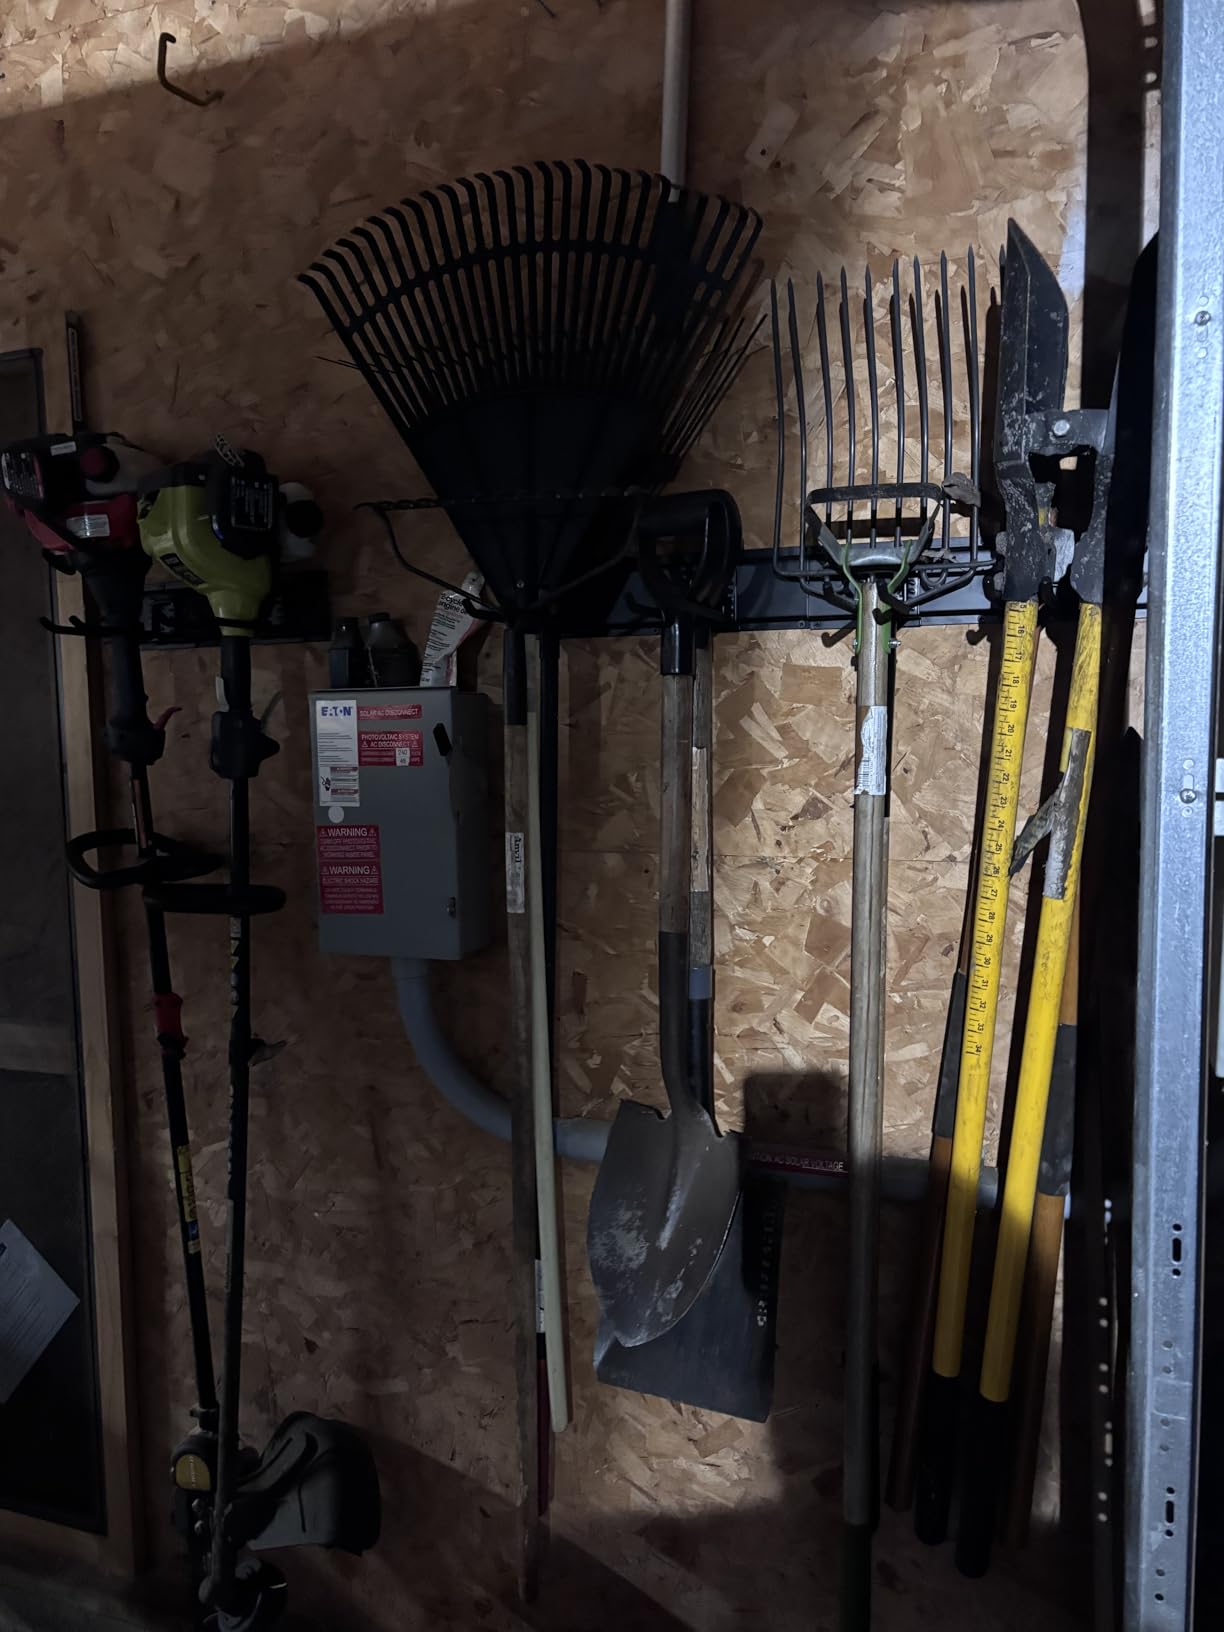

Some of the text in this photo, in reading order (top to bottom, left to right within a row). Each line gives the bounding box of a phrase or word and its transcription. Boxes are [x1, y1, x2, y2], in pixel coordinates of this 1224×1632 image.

[1018, 625, 1025, 634] 16
[1015, 652, 1022, 660] 17
[1012, 676, 1019, 684] 18
[1010, 700, 1017, 708] 19
[1007, 724, 1014, 733] 20
[1005, 749, 1012, 758] 21
[1002, 773, 1010, 782] 22
[1000, 797, 1007, 805] 23
[997, 820, 1005, 829] 24
[328, 828, 368, 836] WARNING
[995, 843, 1002, 852] 25
[329, 866, 370, 874] WARNING
[993, 866, 1000, 875] 26
[991, 889, 998, 898] 27
[988, 912, 996, 920] 28
[986, 934, 993, 943] 29
[984, 957, 991, 966] 30
[982, 979, 989, 988] 31
[979, 1001, 987, 1009] 32
[977, 1023, 985, 1032] 33
[975, 1045, 982, 1053] 34
